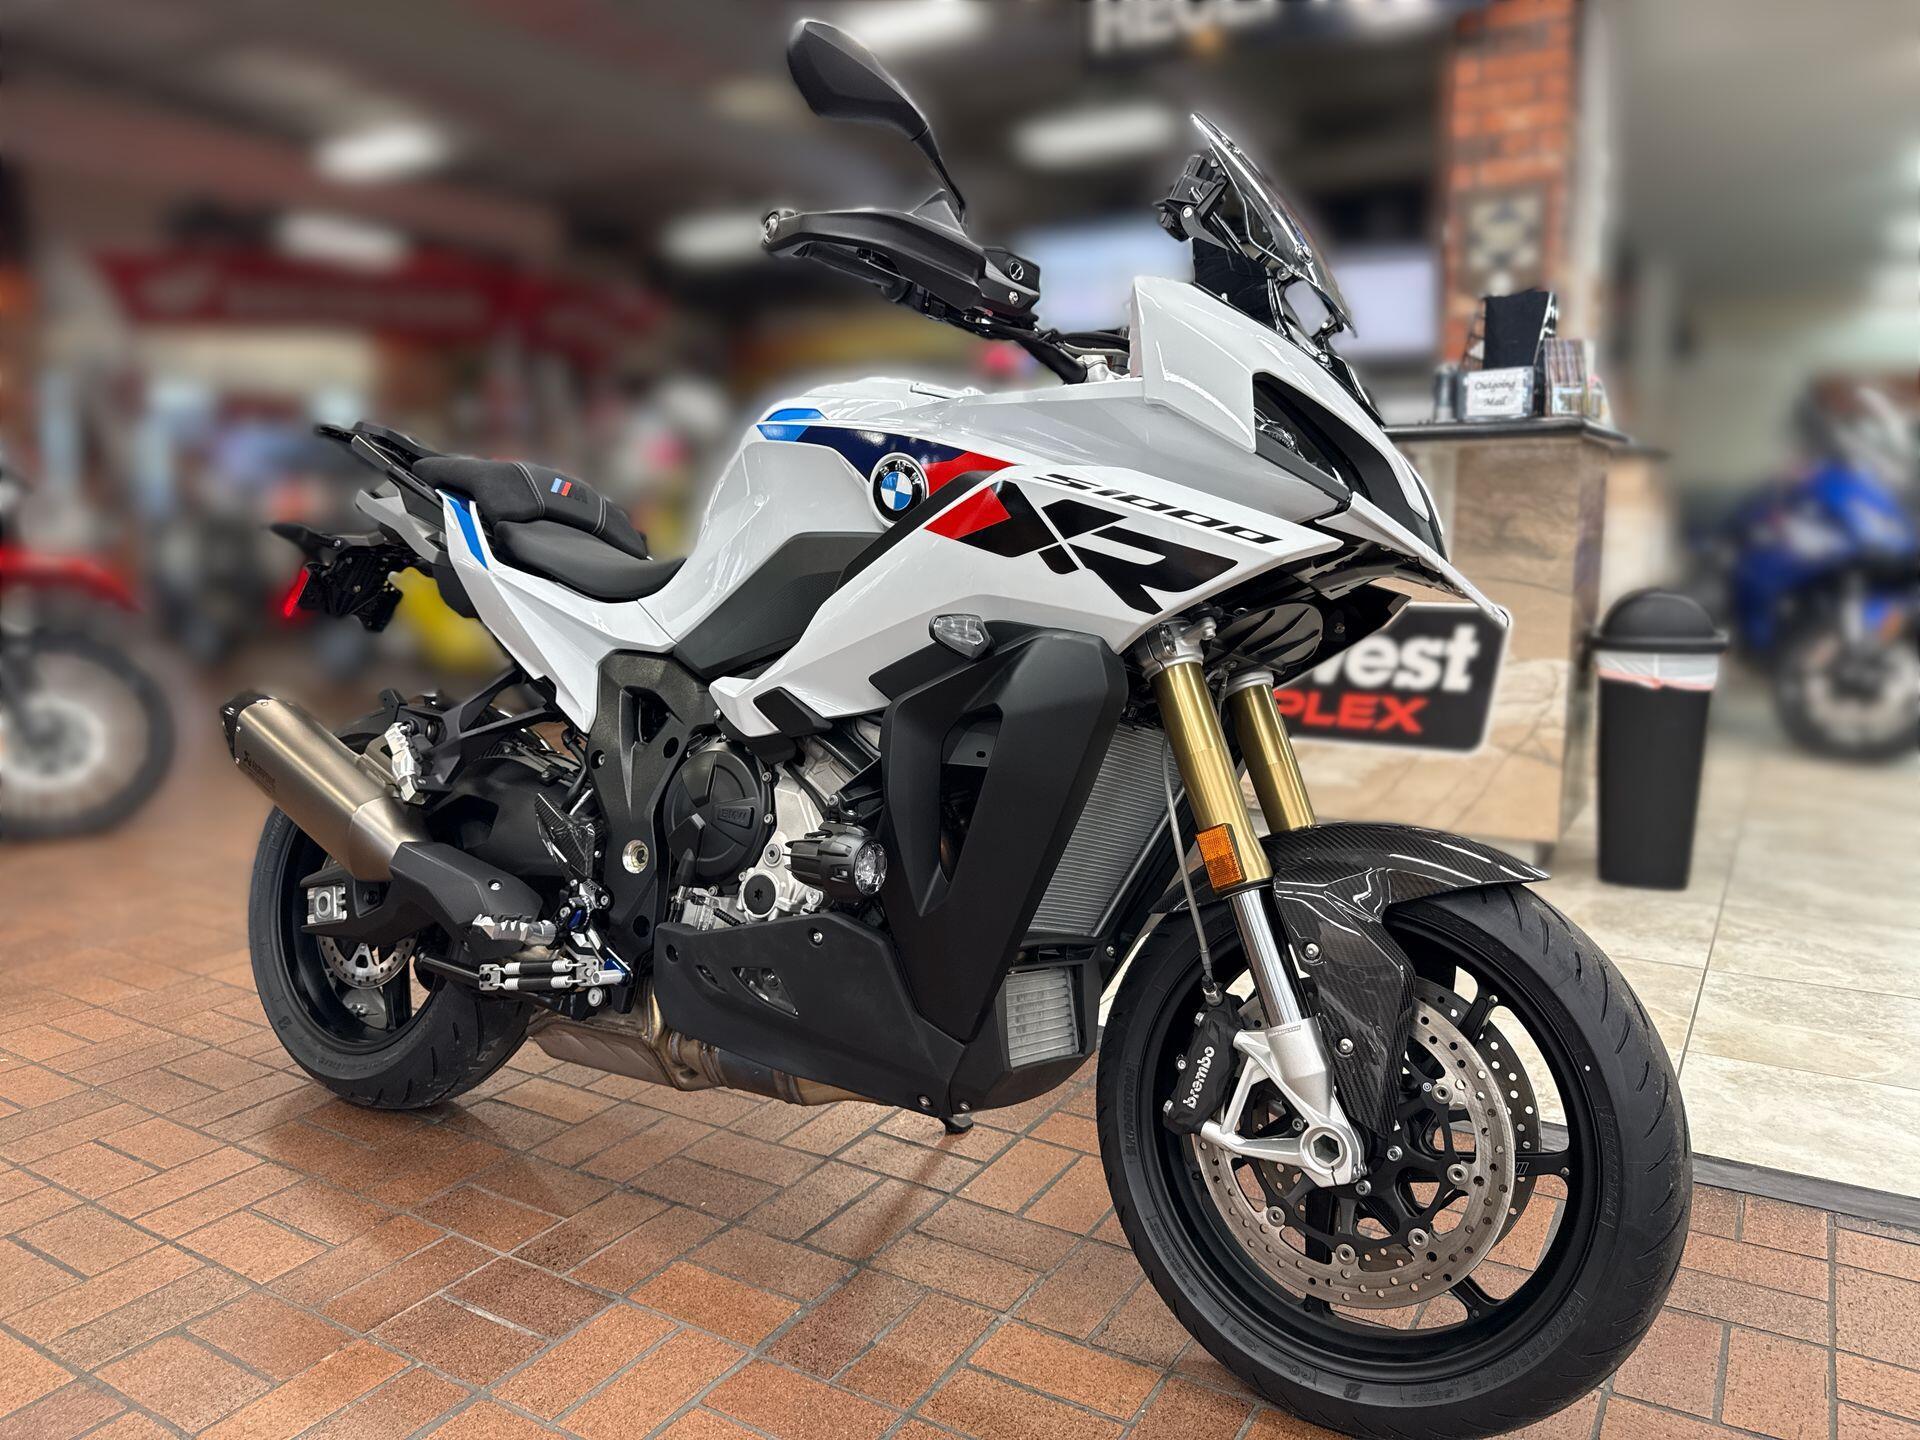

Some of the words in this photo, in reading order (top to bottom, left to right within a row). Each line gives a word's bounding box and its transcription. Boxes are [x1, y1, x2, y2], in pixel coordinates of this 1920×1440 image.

[1474, 380, 1516, 393] Outgoing
[1483, 395, 1508, 407] Mail
[1034, 473, 1283, 544] S1000
[1183, 1046, 1215, 1109] brembo
